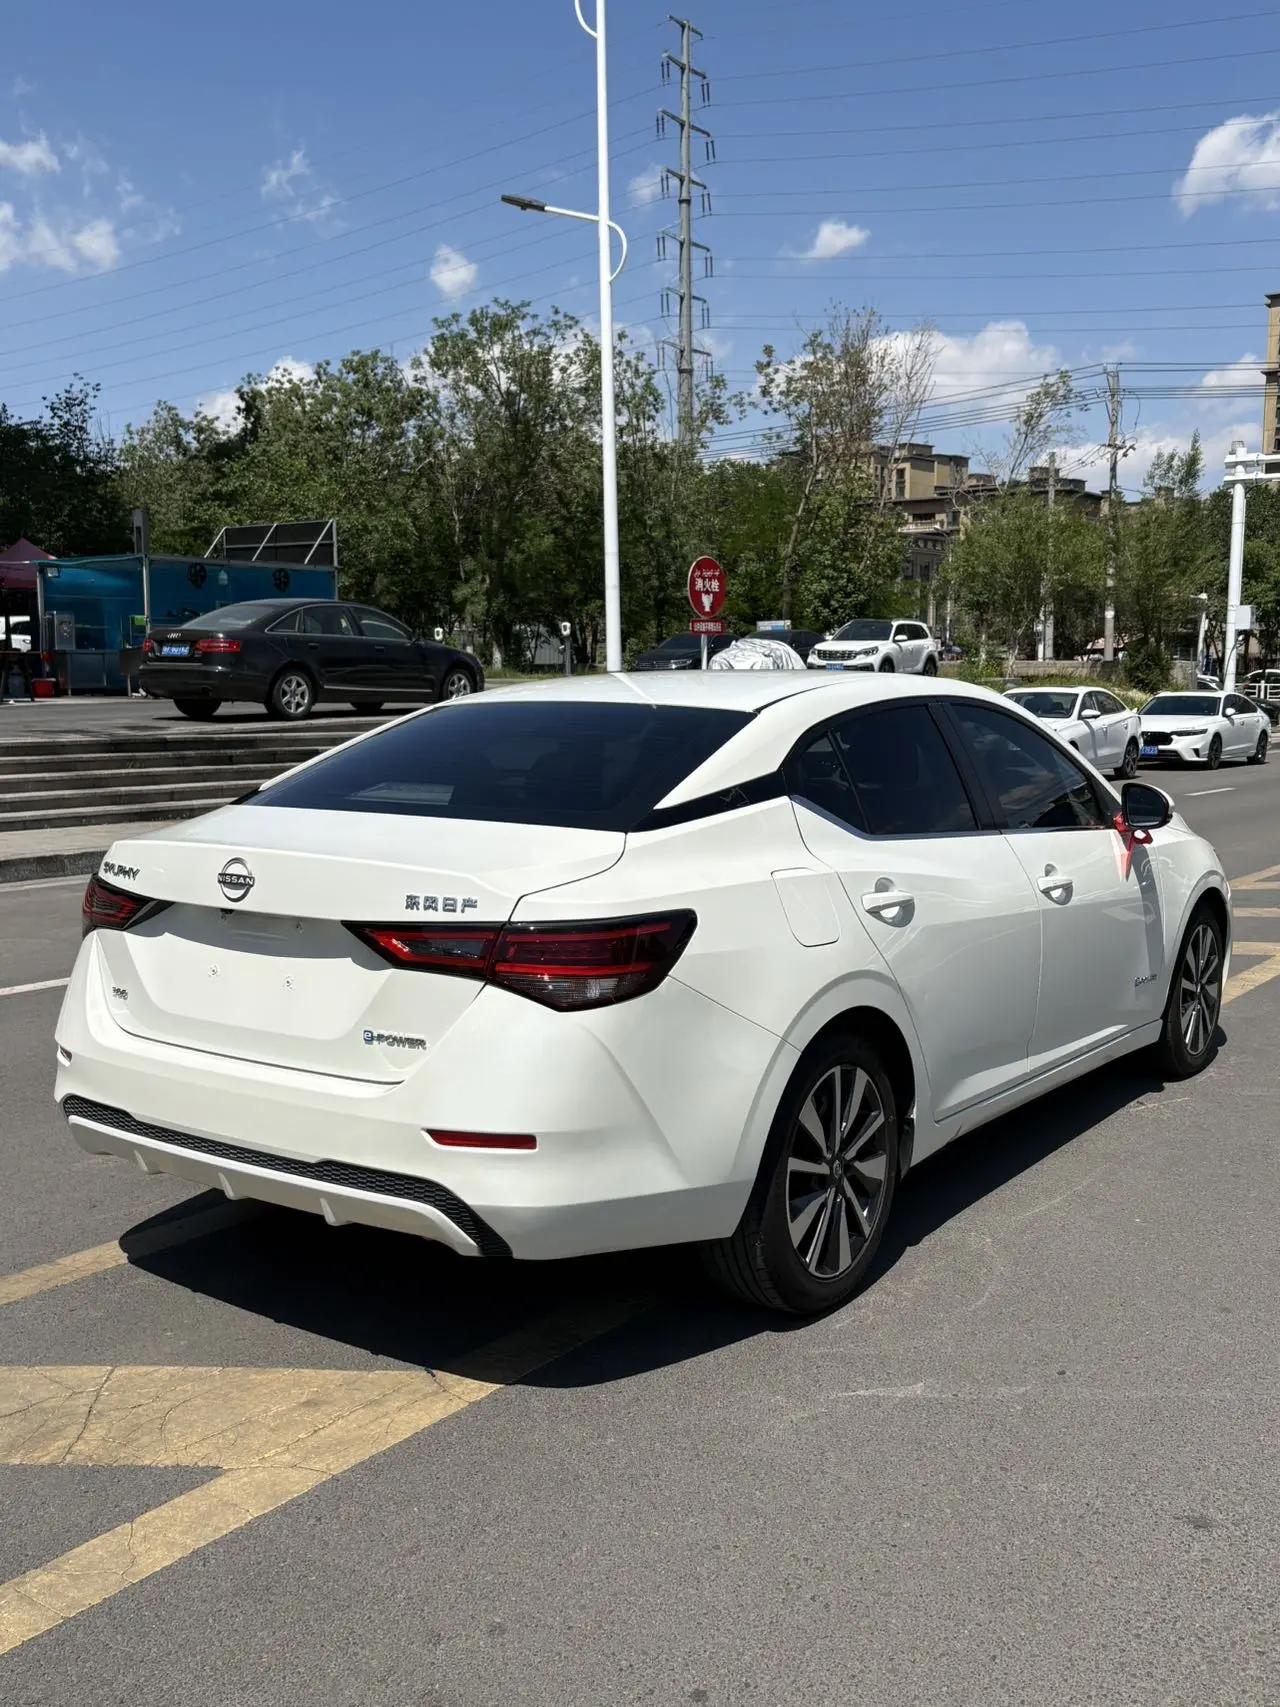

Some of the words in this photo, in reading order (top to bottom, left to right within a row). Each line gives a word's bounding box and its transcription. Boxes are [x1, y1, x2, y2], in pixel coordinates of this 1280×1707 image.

[695, 578, 720, 592] 消火栓
[103, 861, 140, 880] SYLPHY
[218, 874, 254, 887] NISSAN
[405, 894, 478, 913] 东风日产
